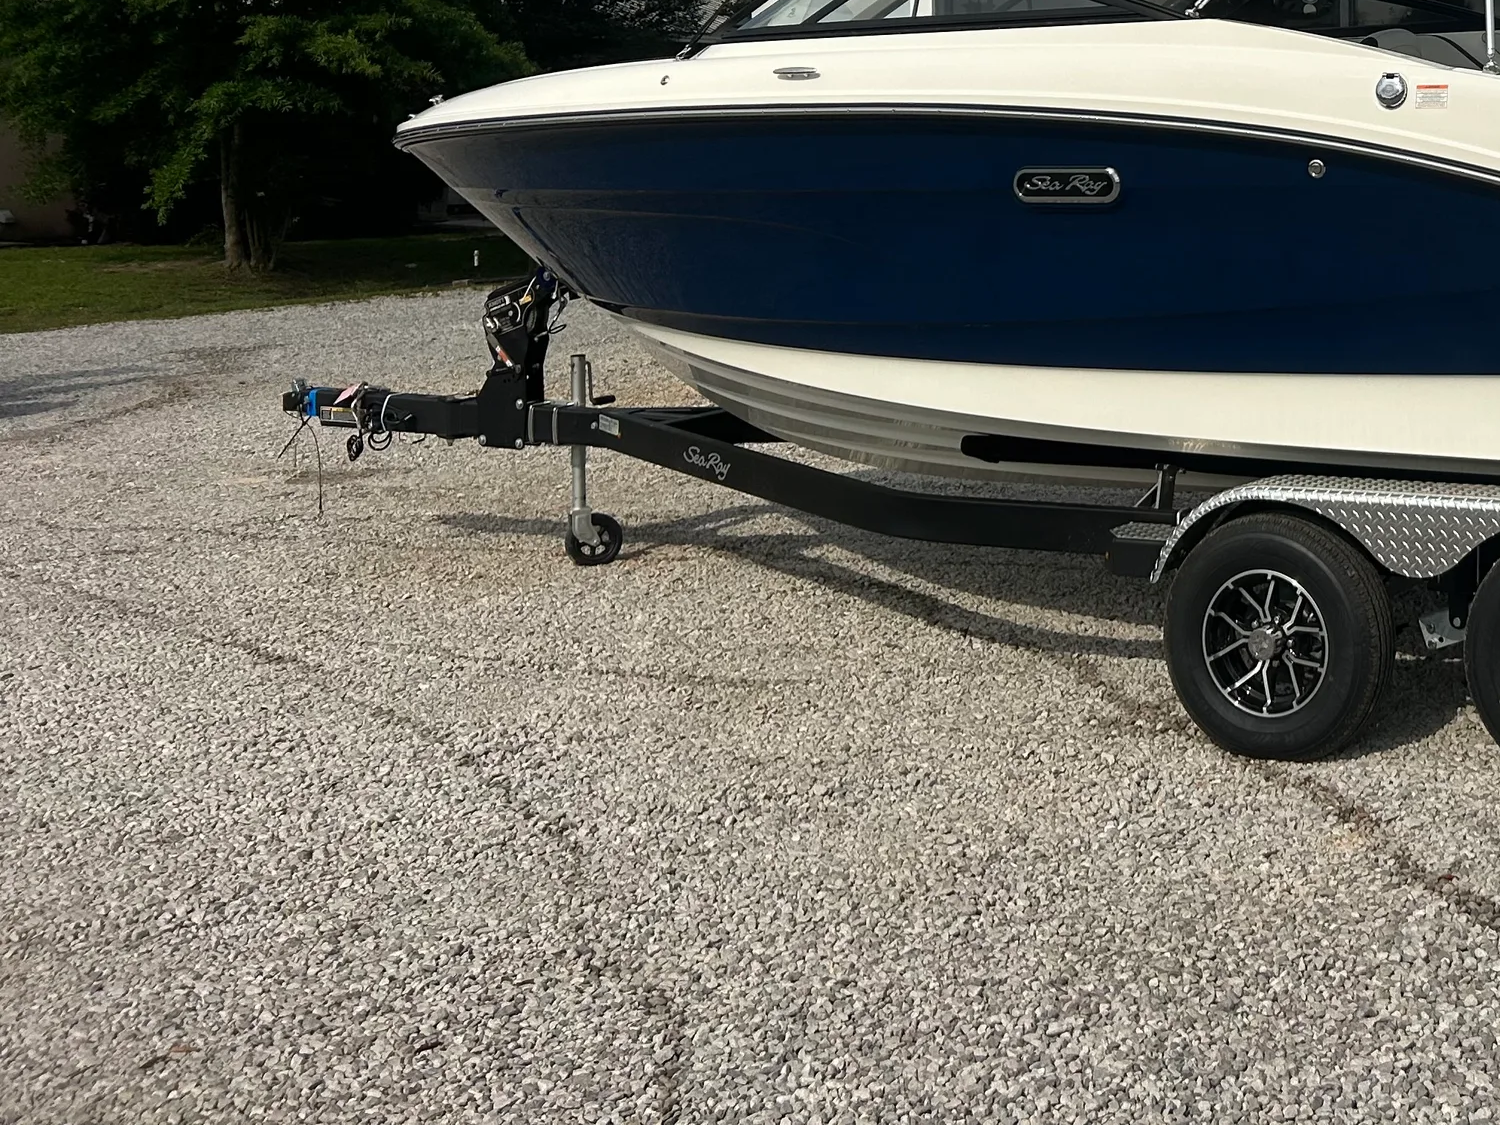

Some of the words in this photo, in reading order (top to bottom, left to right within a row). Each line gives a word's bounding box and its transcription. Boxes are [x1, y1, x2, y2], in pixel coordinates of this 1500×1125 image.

[1024, 175, 1063, 191] Sea
[1064, 174, 1108, 195] Ray
[683, 445, 707, 467] Sea
[705, 452, 731, 481] Ray
